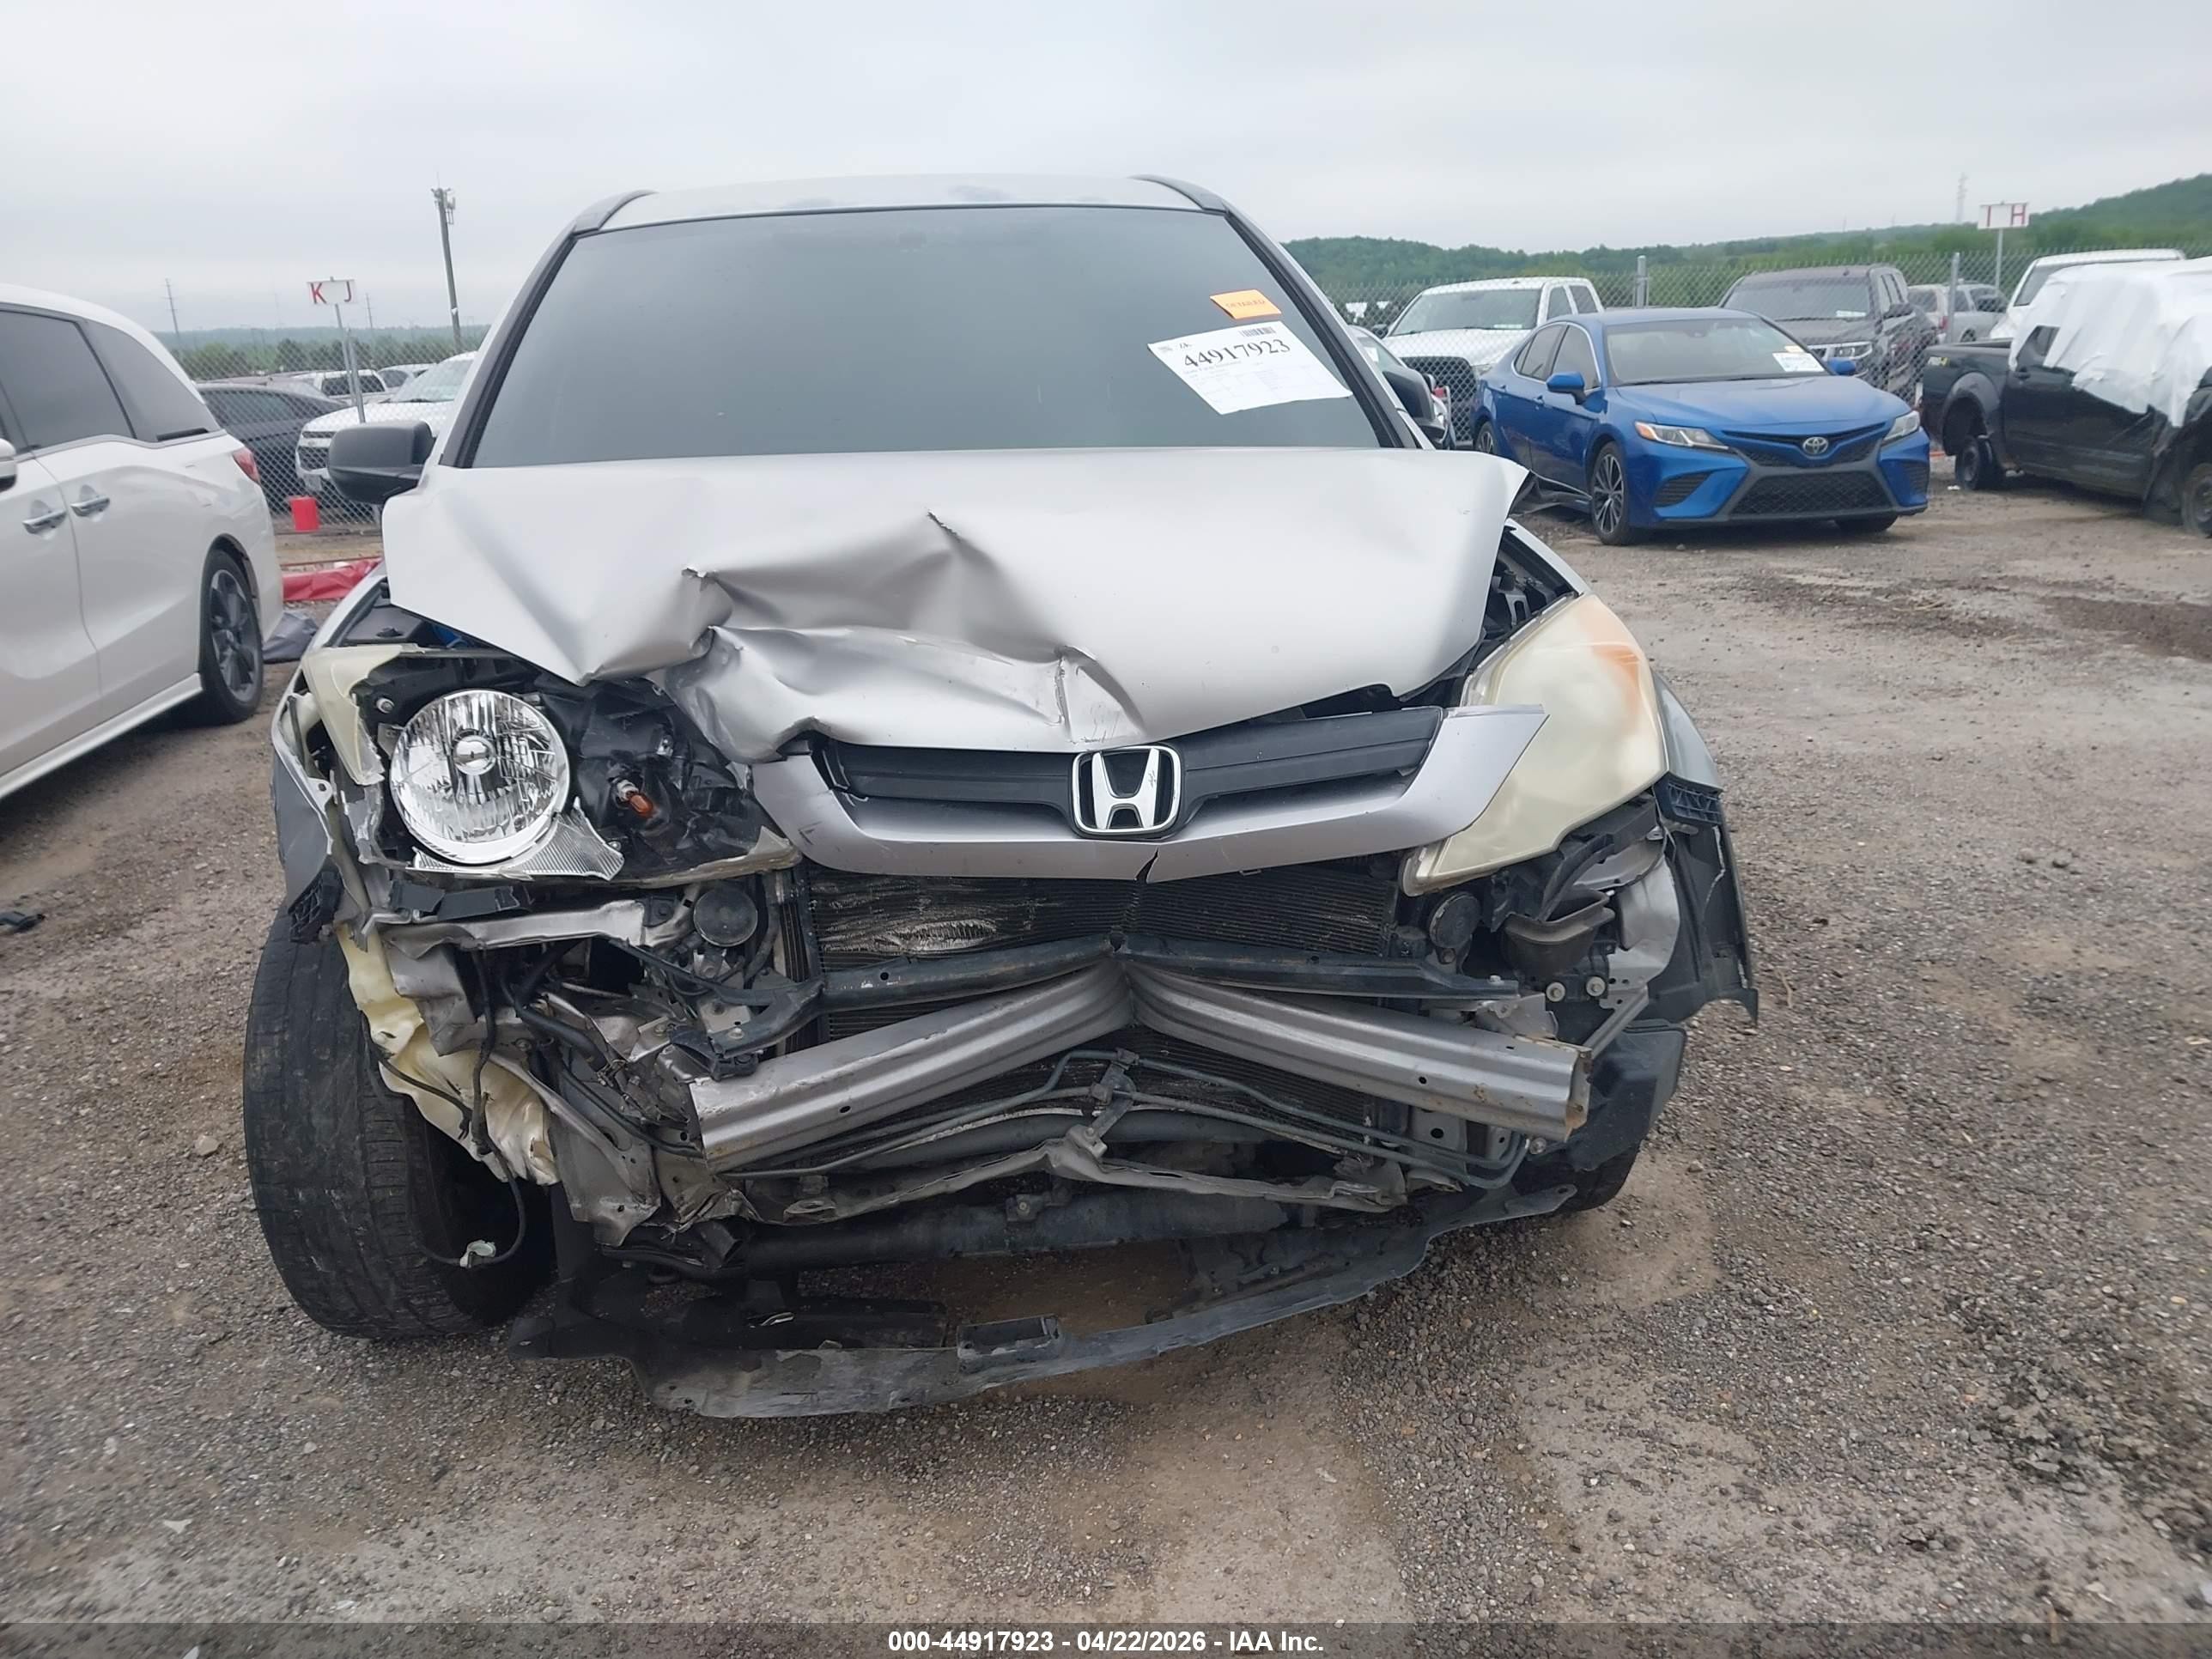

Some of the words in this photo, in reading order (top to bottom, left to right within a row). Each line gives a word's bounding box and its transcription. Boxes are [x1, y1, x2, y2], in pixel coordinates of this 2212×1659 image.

[2010, 203, 2027, 227] H
[310, 282, 327, 305] K
[343, 280, 352, 303] J
[1184, 338, 1291, 368] 44917923
